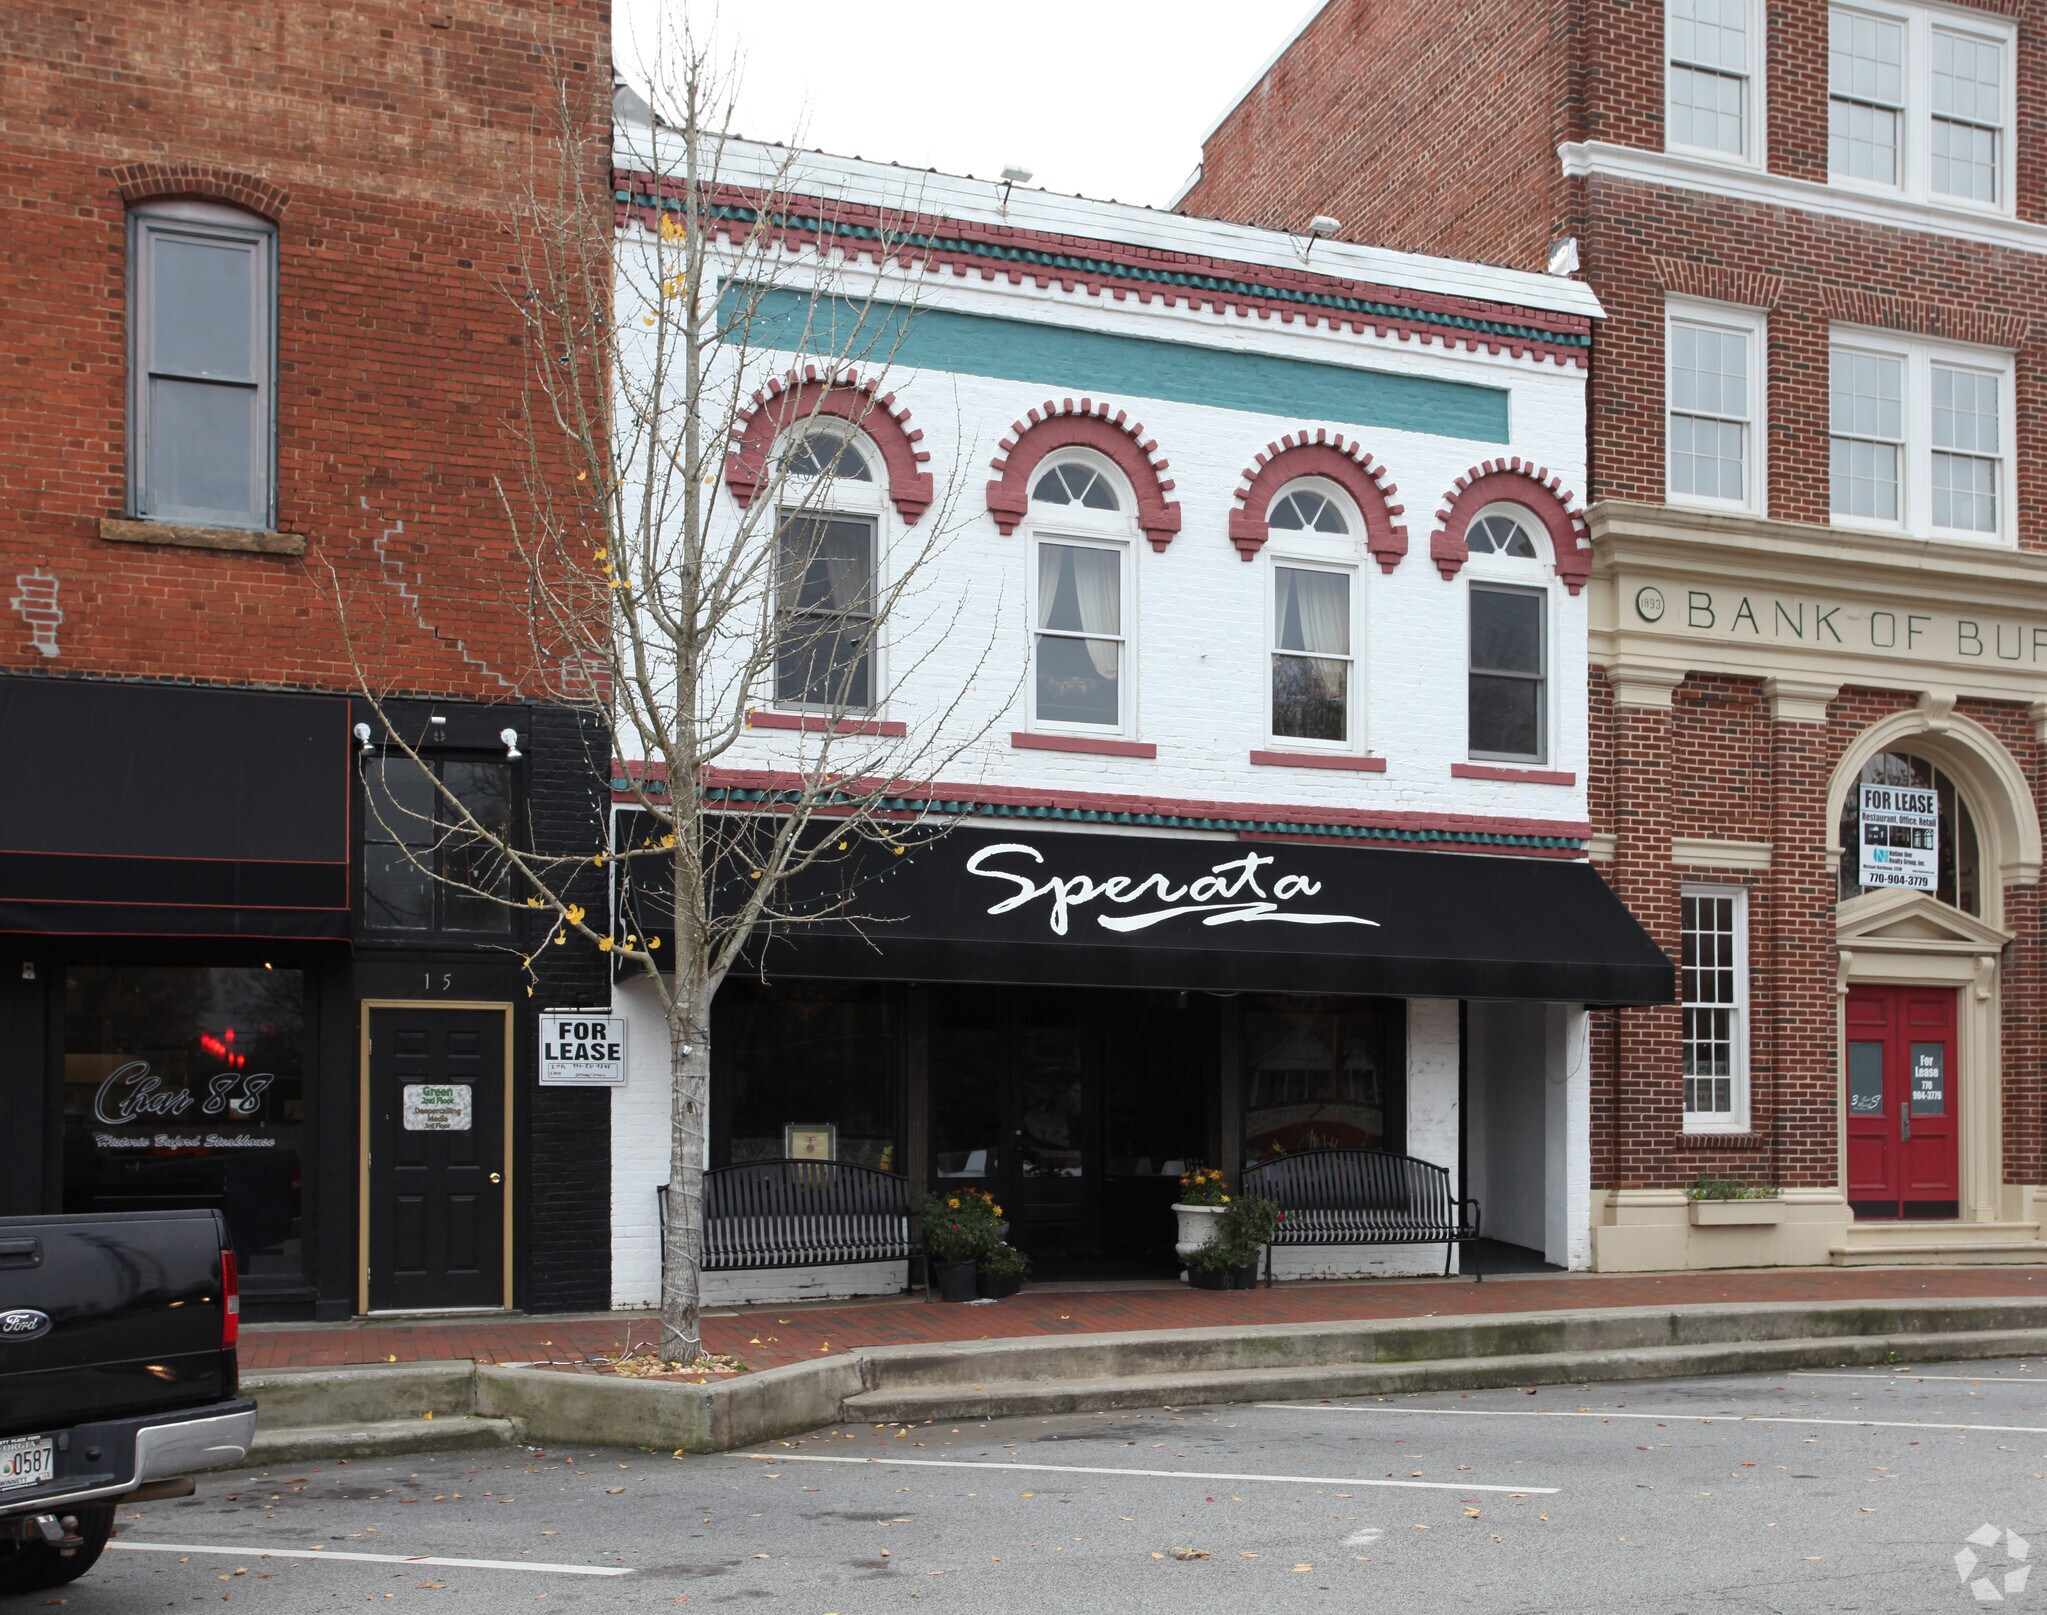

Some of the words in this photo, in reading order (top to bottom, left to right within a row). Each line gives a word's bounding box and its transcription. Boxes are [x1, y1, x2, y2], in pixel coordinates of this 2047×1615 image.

[1641, 597, 1661, 610] 1893
[1687, 591, 1843, 643] BANK
[1870, 611, 1932, 650] OF
[1865, 789, 1891, 810] FOR
[1895, 792, 1934, 814] LEASE
[1919, 817, 1937, 827] Retail
[1869, 872, 1928, 887] 770-904-3779
[967, 843, 1321, 935] Sperata
[424, 973, 452, 991] 15
[559, 1022, 606, 1041] FOR
[545, 1043, 621, 1061] LEASE
[1919, 1054, 1934, 1067] For
[1914, 1066, 1939, 1078] Lease
[95, 1060, 194, 1124] Char
[202, 1072, 275, 1114] 88
[422, 1086, 453, 1097] Green
[1921, 1080, 1933, 1090] 770
[421, 1096, 435, 1105] 2nd
[436, 1096, 454, 1105] Floor
[1912, 1090, 1942, 1100] 904-3779
[427, 1114, 448, 1122] Media
[96, 1133, 150, 1147] Historic
[154, 1133, 201, 1150] Buford
[203, 1133, 276, 1147] Steakhouse
[3, 1314, 38, 1332] Ford
[14, 1447, 51, 1475] 0587
